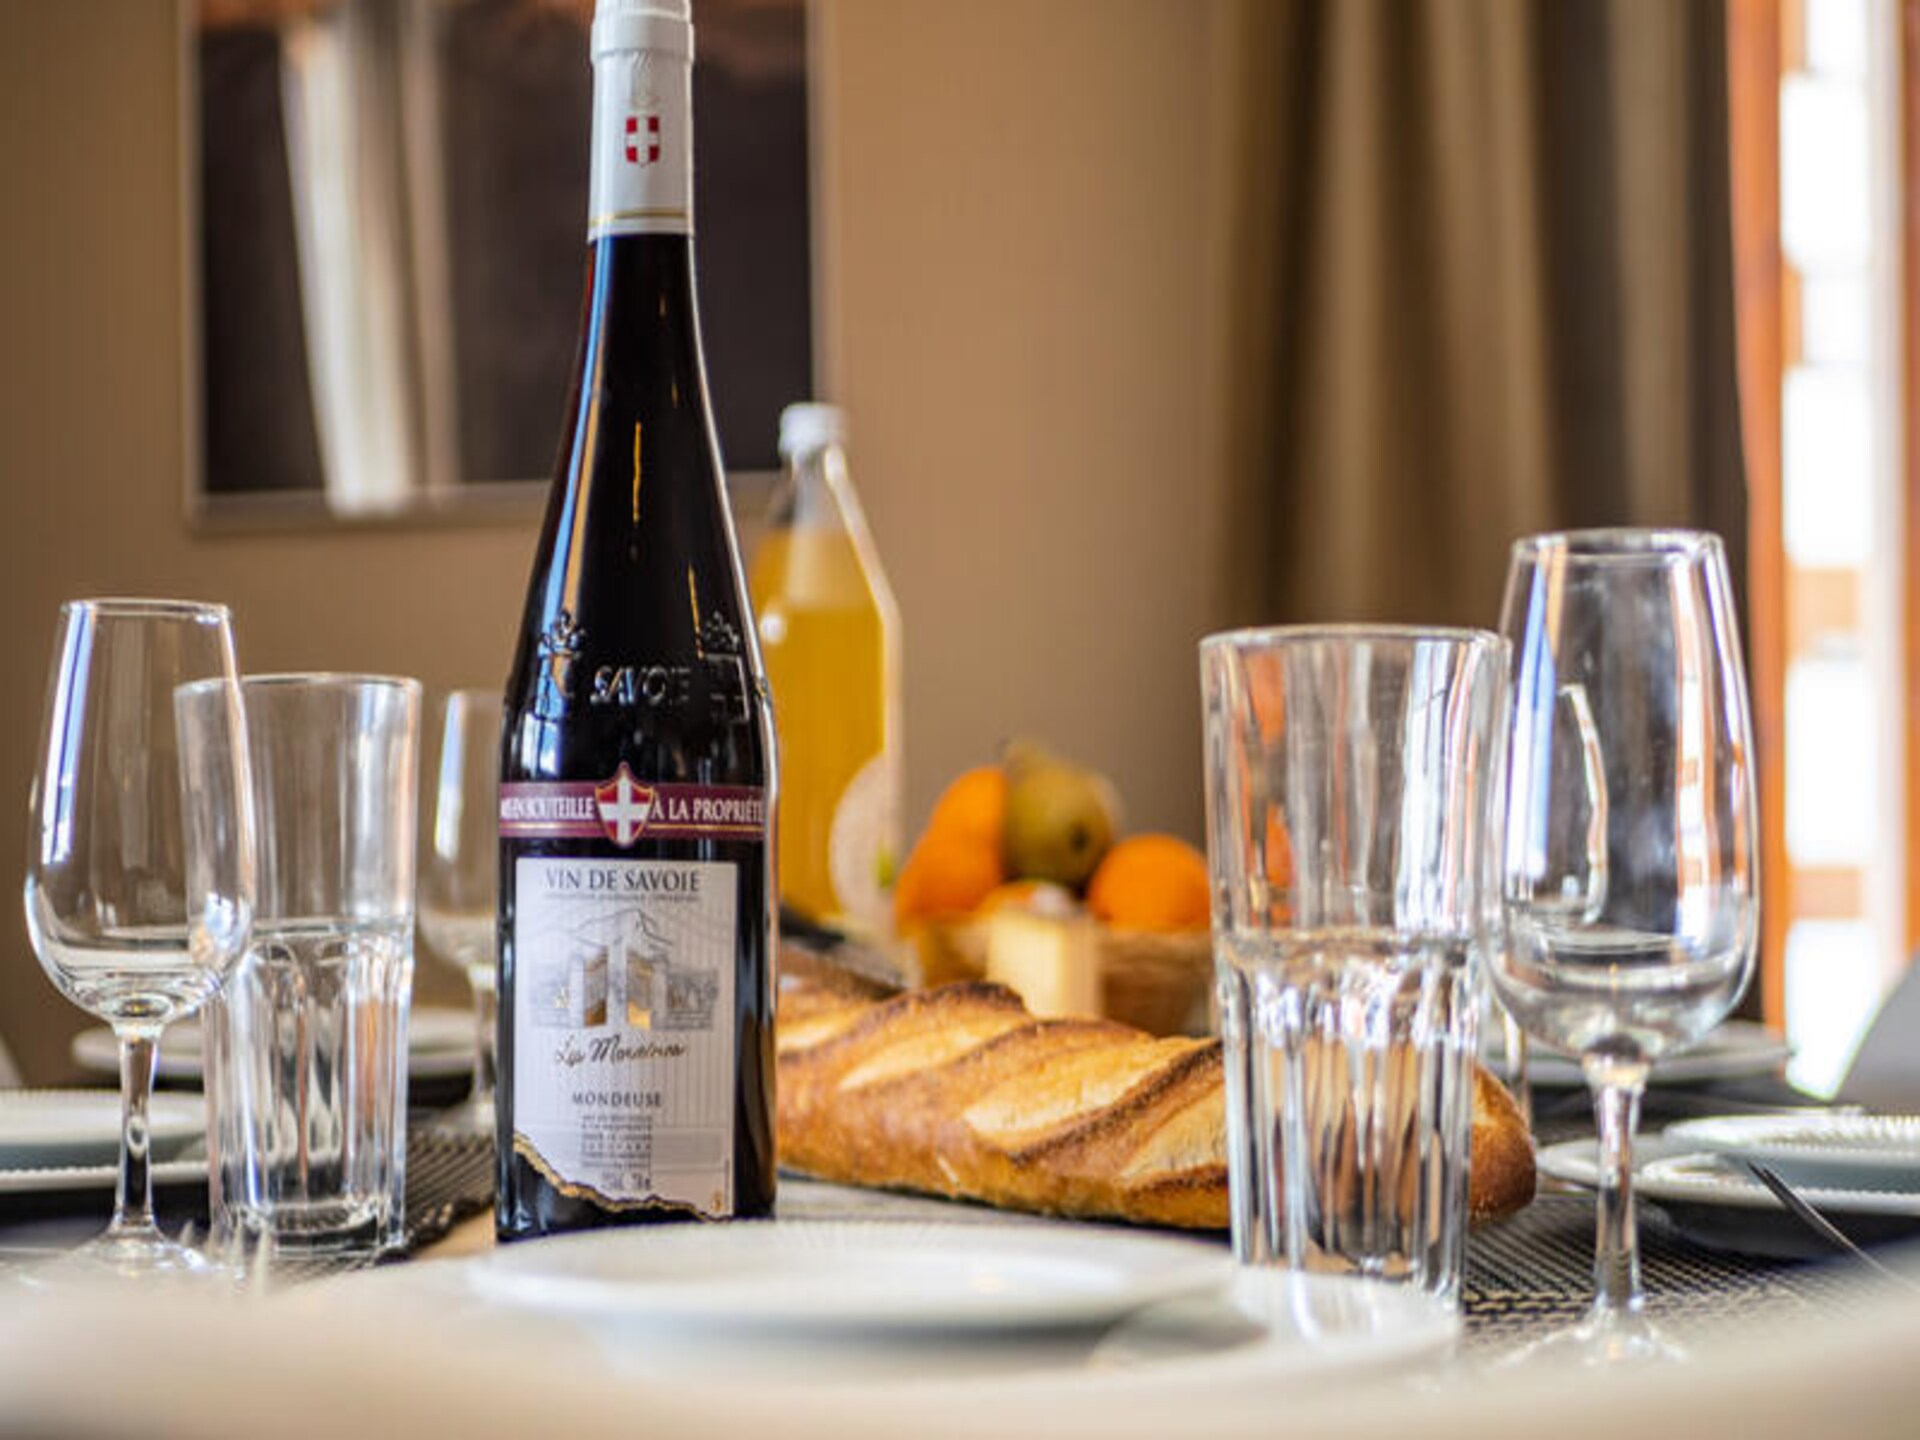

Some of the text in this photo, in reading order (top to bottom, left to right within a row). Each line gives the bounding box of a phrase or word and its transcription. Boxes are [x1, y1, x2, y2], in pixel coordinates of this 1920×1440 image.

[669, 797, 689, 820] LA
[547, 868, 700, 891] VIN DE SAVOIE
[573, 1090, 661, 1108] MONDEUSE
